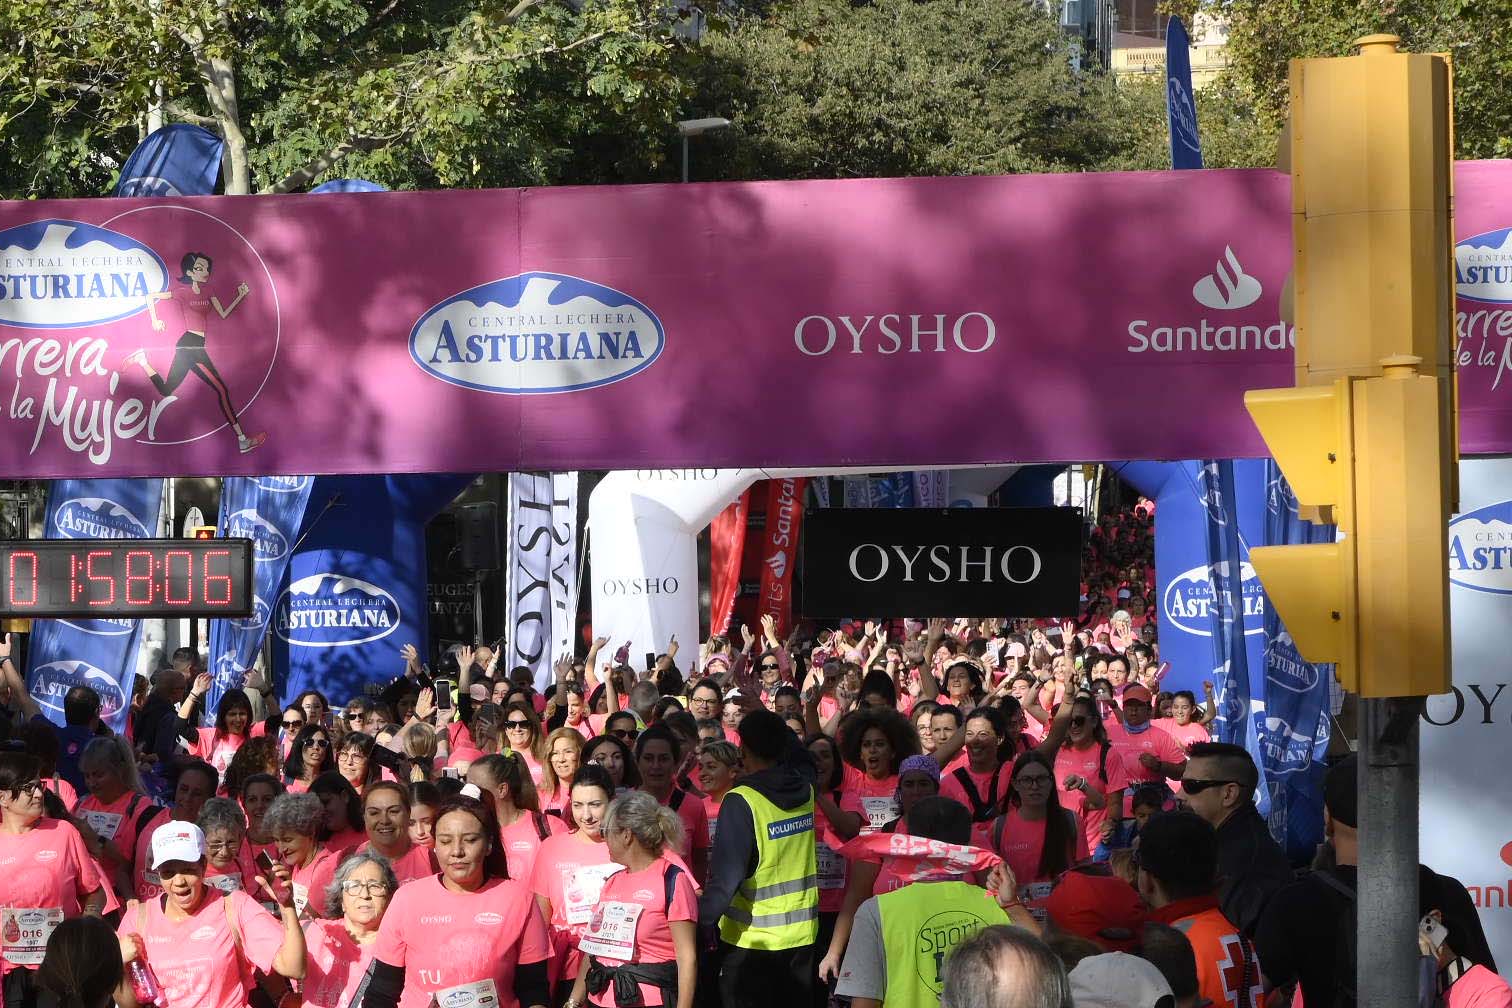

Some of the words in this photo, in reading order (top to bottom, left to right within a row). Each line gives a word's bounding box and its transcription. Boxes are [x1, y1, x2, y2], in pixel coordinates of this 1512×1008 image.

[72, 254, 144, 267] LECHERA
[467, 312, 547, 327] CENTRAL
[554, 311, 637, 325] LECHERA
[429, 319, 645, 363] ASTURIANA
[794, 311, 996, 356] OYSHO
[9, 379, 34, 421] la
[29, 370, 179, 466] Mujer
[848, 543, 1041, 584] OYSHO
[602, 576, 680, 596] OYSHO
[290, 599, 334, 607] CENTRAL
[279, 604, 391, 629] ASTURIANA
[1419, 683, 1512, 727] OY
[22, 929, 43, 938] 016
[419, 969, 441, 985] TU
